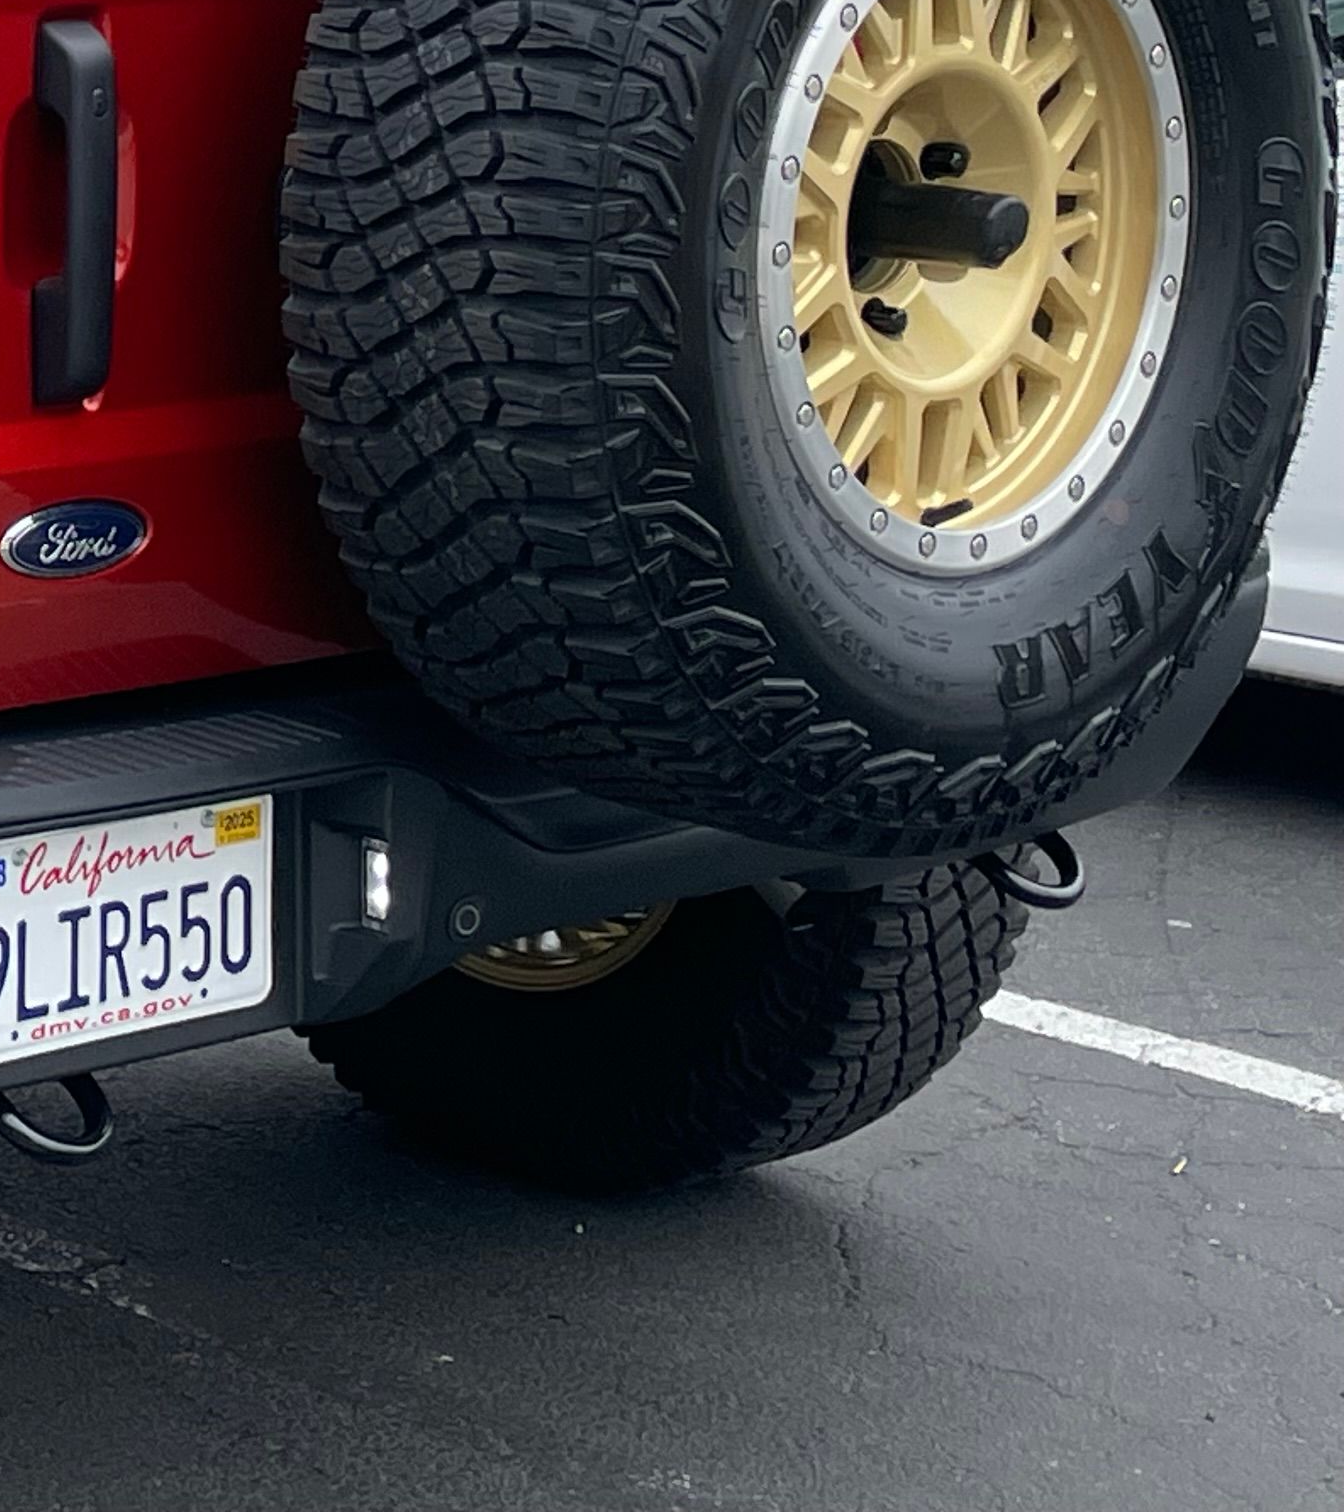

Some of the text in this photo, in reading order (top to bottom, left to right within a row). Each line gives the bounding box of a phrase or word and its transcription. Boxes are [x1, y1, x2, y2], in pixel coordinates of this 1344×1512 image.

[39, 522, 118, 565] Ford
[19, 831, 215, 898] California
[30, 993, 193, 1041] dmv.ca.gov
